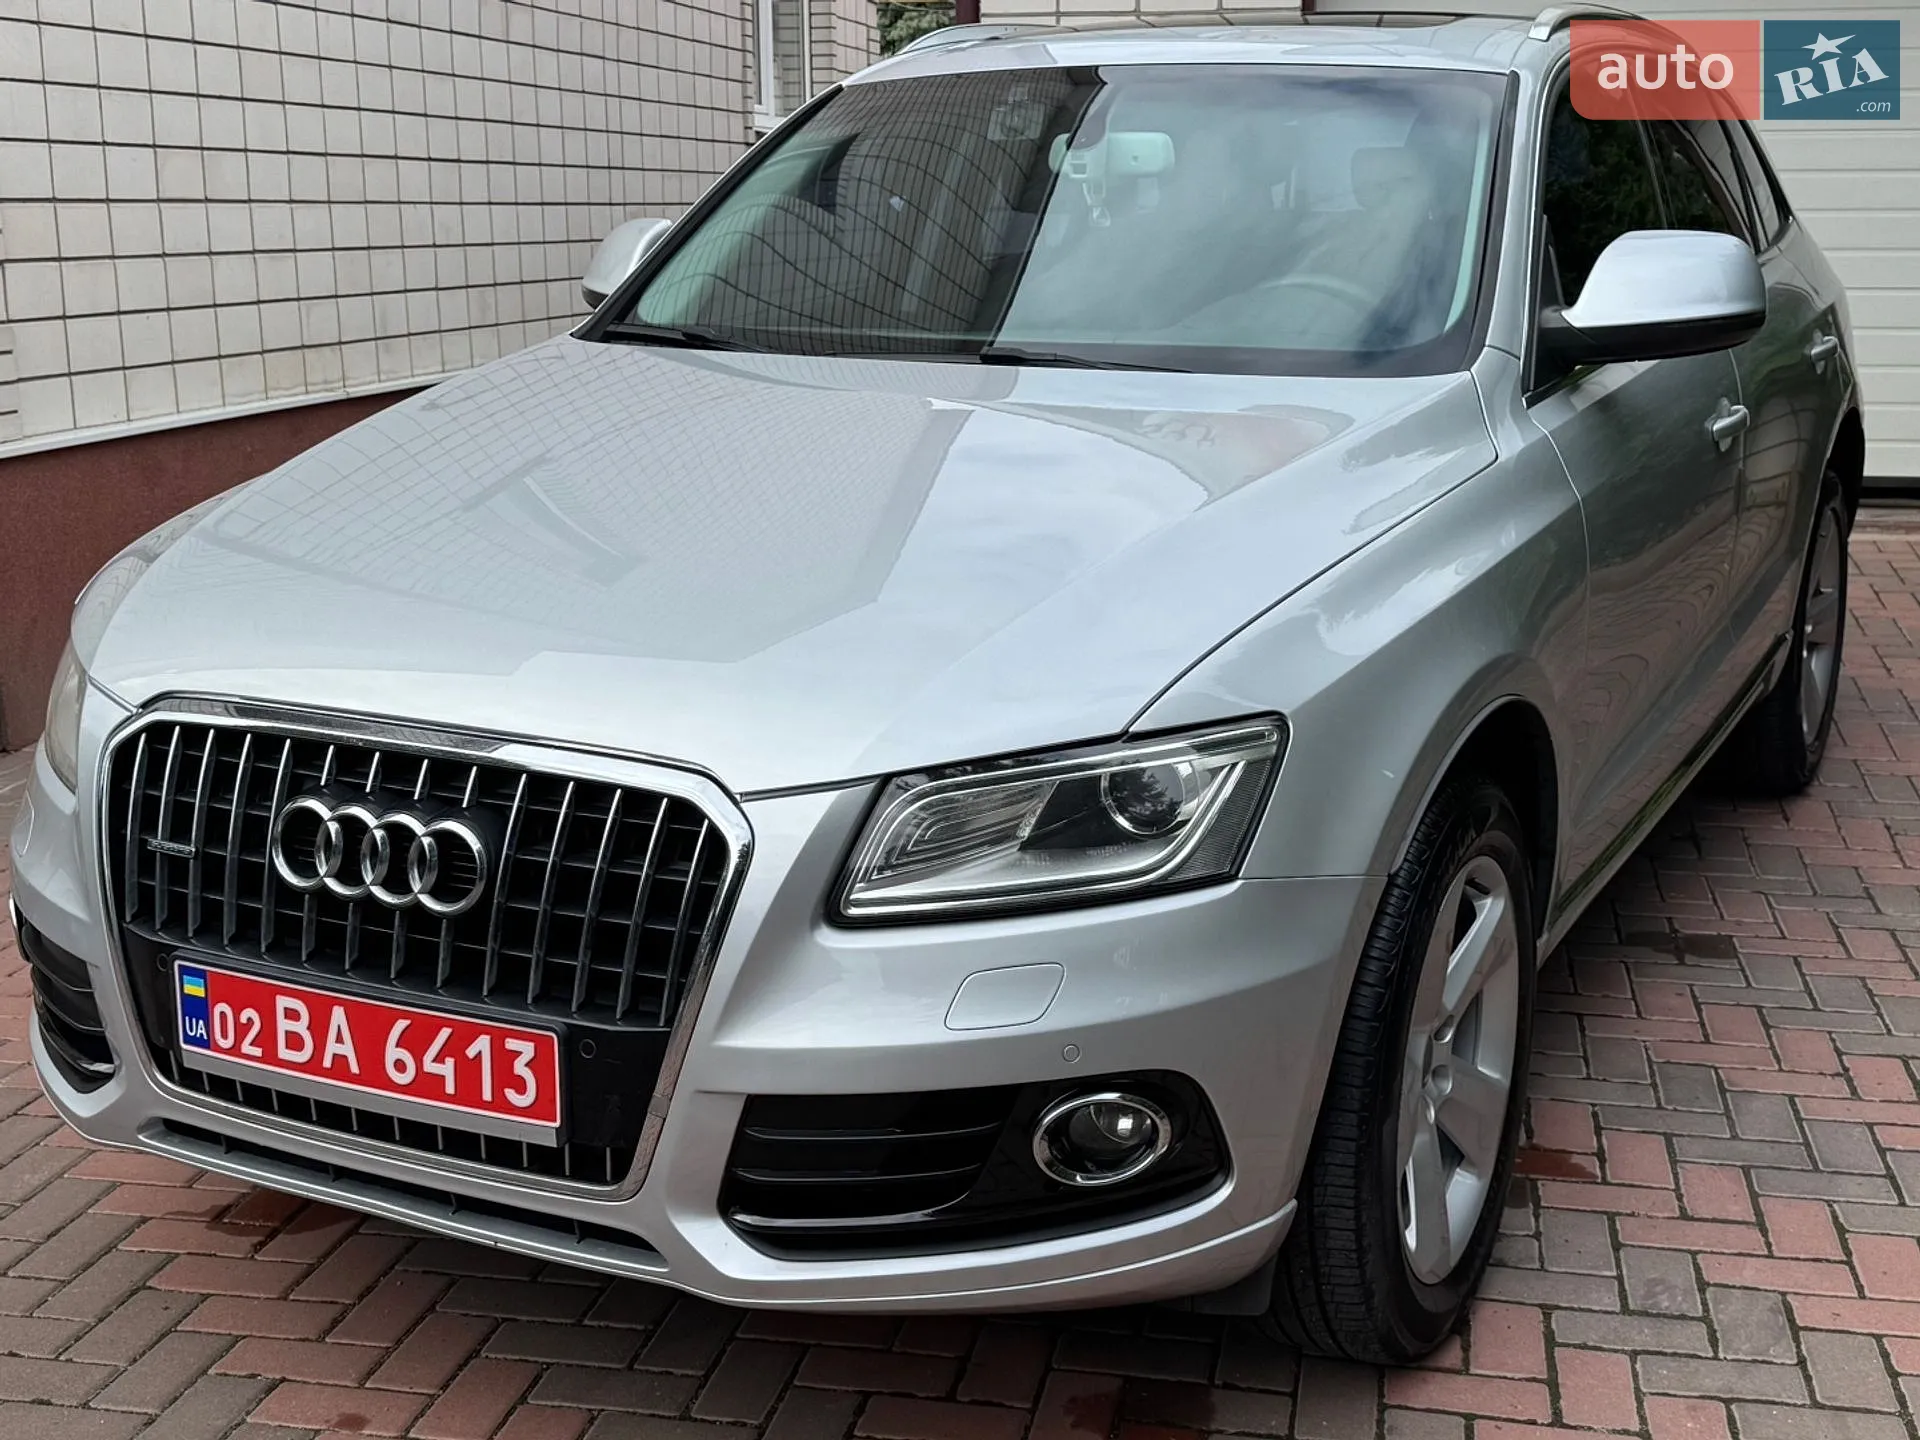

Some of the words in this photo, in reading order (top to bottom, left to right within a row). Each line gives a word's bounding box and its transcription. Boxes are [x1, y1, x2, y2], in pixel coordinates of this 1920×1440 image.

[185, 1015, 208, 1040] UA
[213, 1002, 263, 1058] 02
[275, 994, 360, 1075] BA
[384, 1018, 538, 1108] 6413
